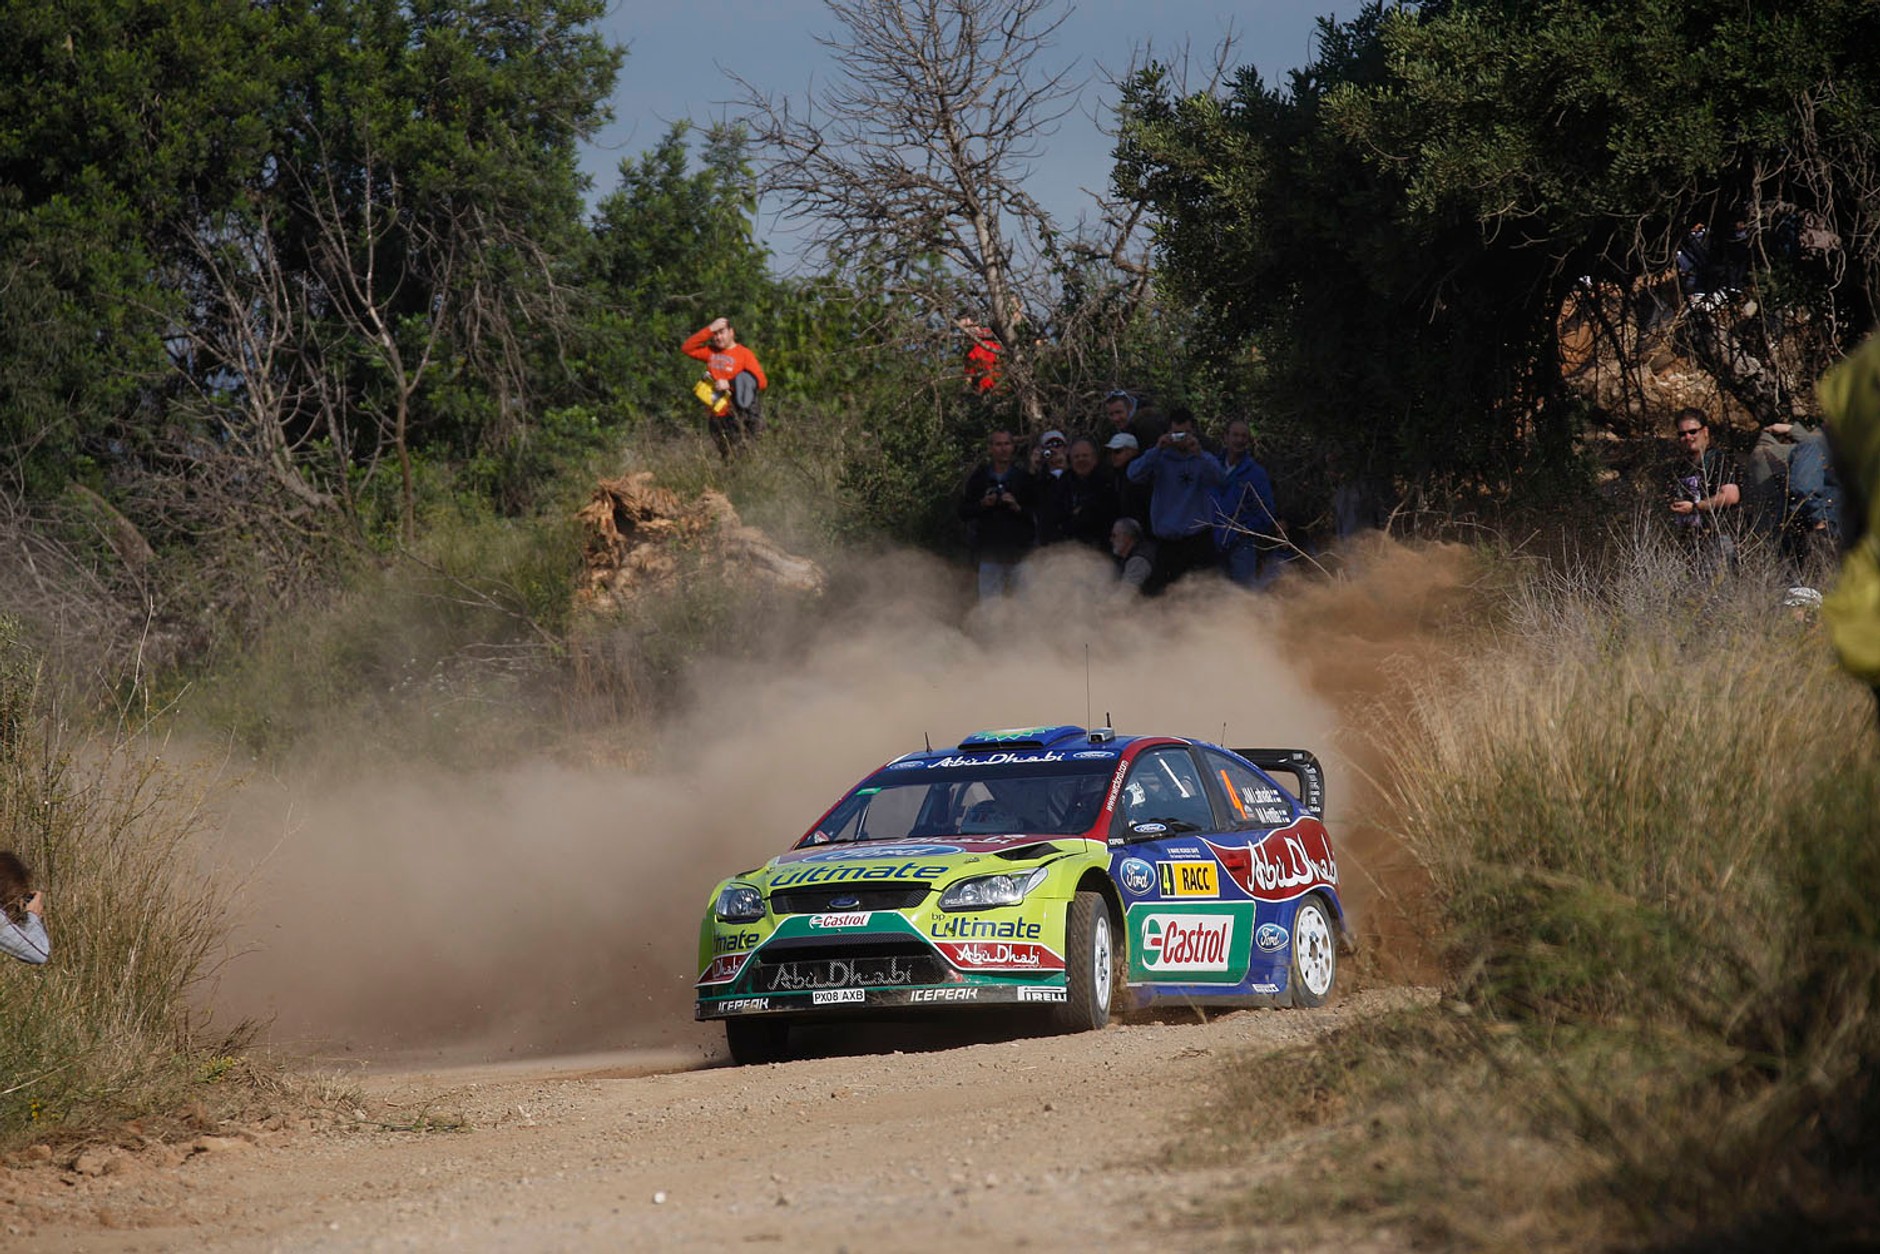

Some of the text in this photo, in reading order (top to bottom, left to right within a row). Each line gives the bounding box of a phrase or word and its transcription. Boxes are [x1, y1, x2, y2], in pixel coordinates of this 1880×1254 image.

[928, 751, 1066, 769] Abu Dhabi
[1219, 769, 1248, 820] 4
[770, 862, 950, 886] ultimate
[1126, 862, 1149, 888] Ford
[1247, 838, 1287, 892] Abu
[1163, 864, 1211, 895] 4 RACC
[823, 914, 866, 927] Castrol
[931, 913, 945, 921] bp
[931, 916, 1041, 939] ultimate
[1163, 920, 1227, 964] Castrol
[1260, 927, 1280, 946] Ford
[956, 944, 1041, 965] Abu Dhabi
[767, 956, 913, 990] Abu Dhabi
[718, 998, 769, 1012] ICEPEAK
[815, 990, 864, 1002] PX08 AXB
[910, 988, 979, 1002] ICEPEAK
